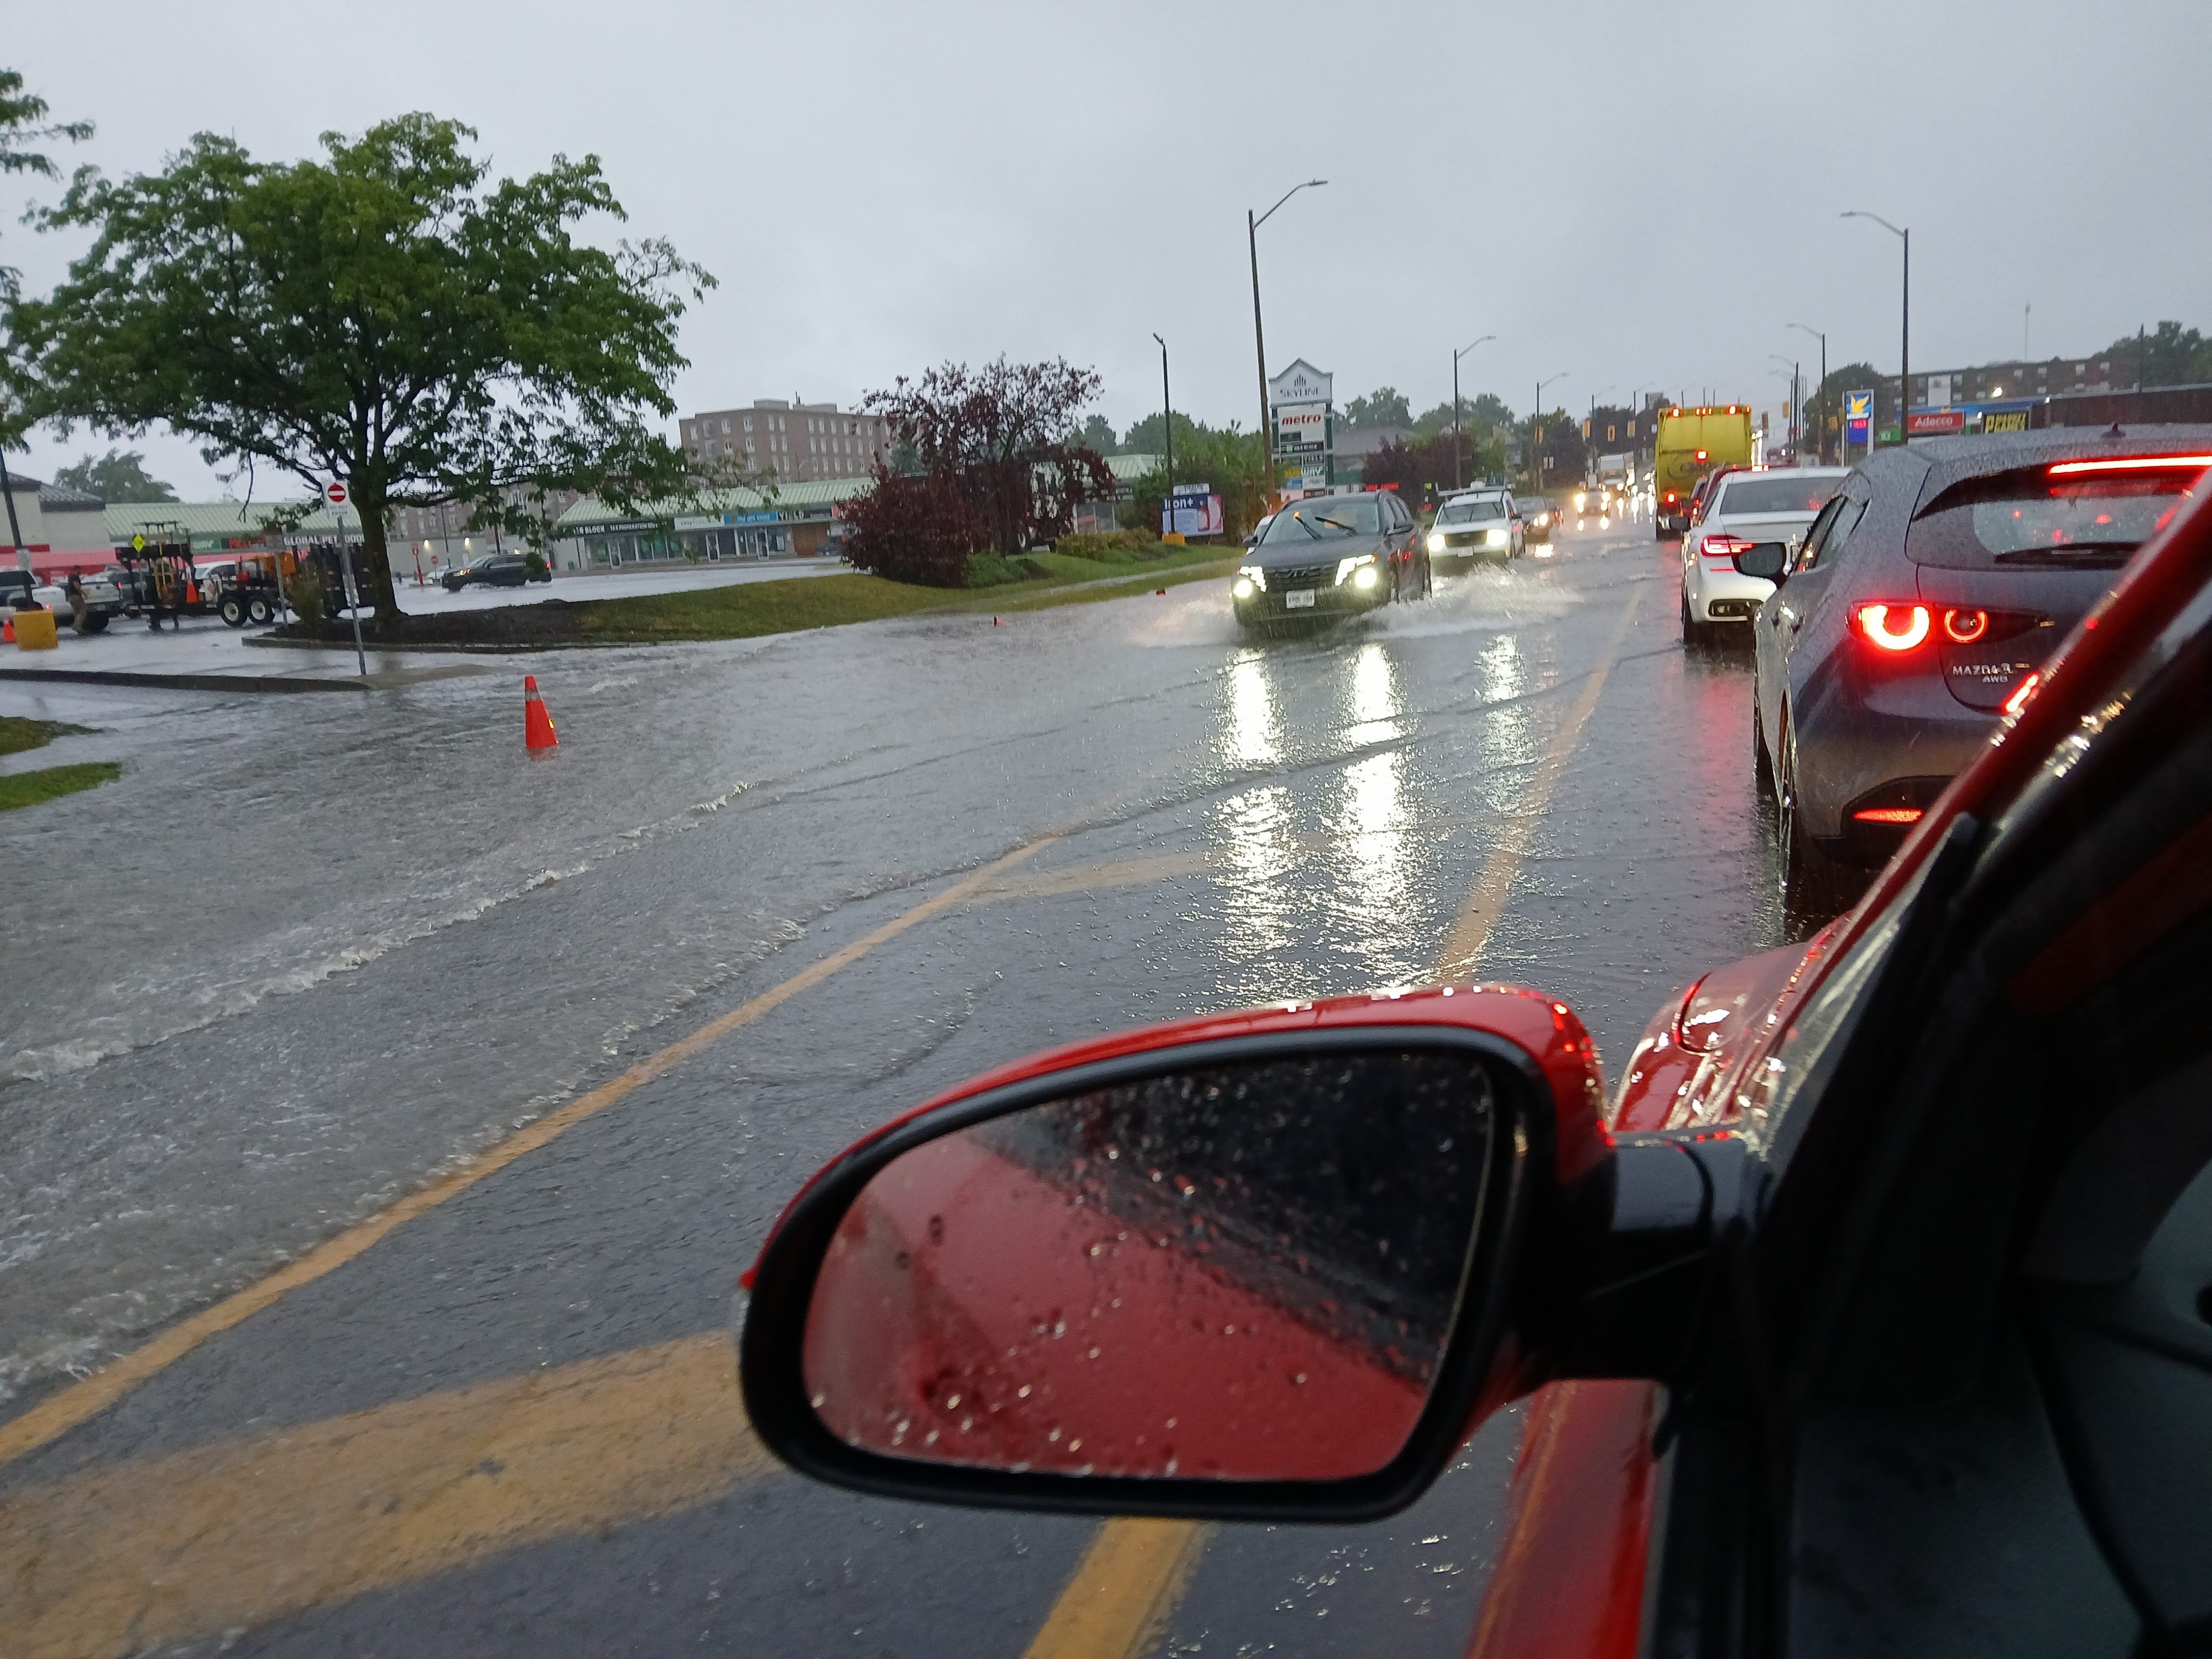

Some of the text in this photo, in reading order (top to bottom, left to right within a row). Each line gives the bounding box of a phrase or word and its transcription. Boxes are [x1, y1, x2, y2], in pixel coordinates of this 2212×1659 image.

[1281, 414, 1321, 425] metro
[284, 533, 365, 546] GLOBAL PET OOD
